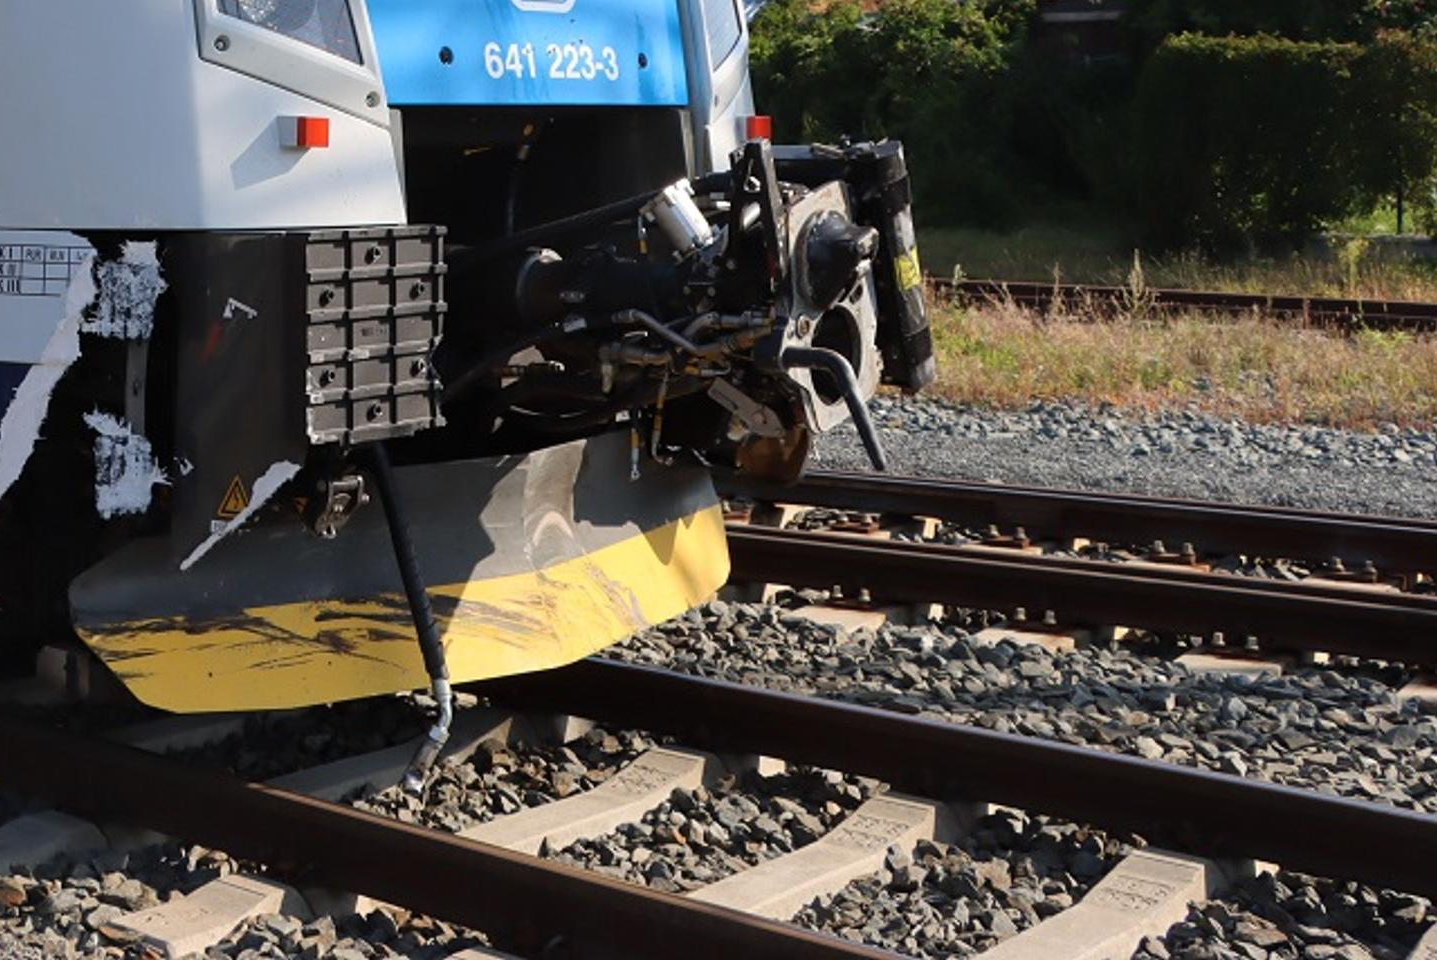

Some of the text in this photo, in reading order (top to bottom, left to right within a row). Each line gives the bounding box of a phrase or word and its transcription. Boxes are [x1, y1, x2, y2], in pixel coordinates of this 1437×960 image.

[484, 41, 619, 80] 641 223-3
[7, 279, 20, 293] III
